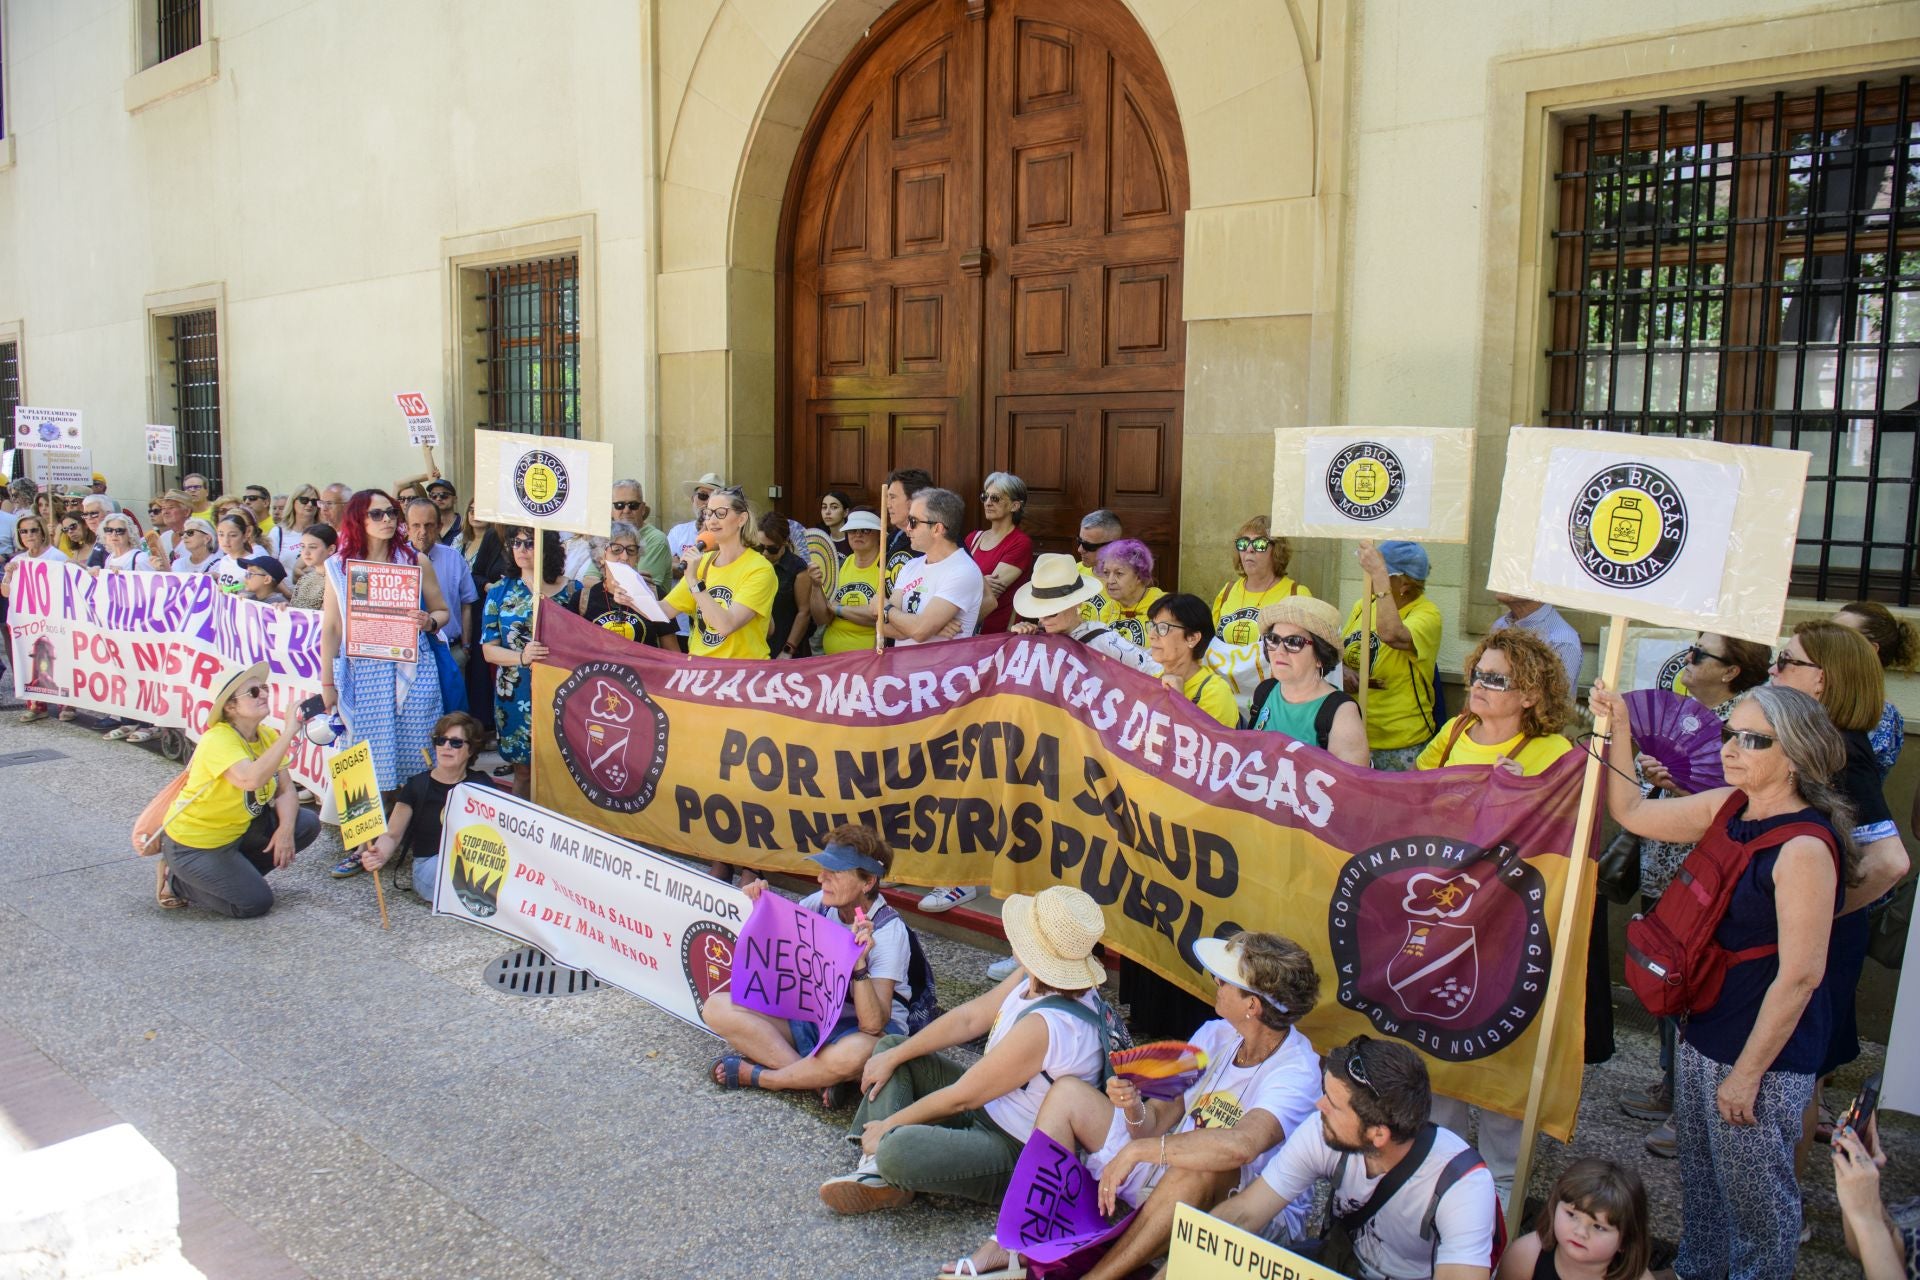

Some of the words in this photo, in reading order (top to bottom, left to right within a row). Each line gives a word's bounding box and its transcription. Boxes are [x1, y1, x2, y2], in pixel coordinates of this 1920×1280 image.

[399, 396, 426, 415] NO
[517, 455, 533, 485] STOP
[1330, 450, 1353, 485] STOP
[522, 496, 562, 513] MOLINA
[1338, 497, 1394, 517] MOLINA
[1576, 476, 1613, 527] STOP
[1629, 470, 1683, 540] BIOGÁS
[370, 573, 402, 588] STOP
[1583, 548, 1664, 582] MOLINA
[15, 559, 51, 617] NO
[63, 564, 77, 620] A
[245, 602, 288, 674] DE
[370, 584, 416, 602] BIOGÁS
[12, 618, 47, 640] STOP
[72, 630, 126, 670] POR
[72, 667, 127, 708] POR
[554, 662, 625, 727] OORDINADORA
[331, 747, 369, 780] ¿BIOGÁS?
[713, 669, 747, 703] A
[746, 669, 813, 709] LAS
[1117, 700, 1171, 765] DE
[1171, 722, 1337, 829] BIOGÁS
[719, 727, 826, 799] POR
[834, 720, 1061, 803] NUESTRA
[561, 748, 599, 800] MURCIA
[674, 783, 783, 851] POR
[461, 846, 478, 864] MAR
[477, 852, 507, 873] MENOR
[462, 834, 481, 850] STOP
[480, 838, 507, 858] BIOGÁS
[464, 796, 496, 822] STOP
[498, 811, 545, 845] BIOGÁS
[549, 832, 580, 860] MAR
[582, 844, 633, 881] MENOR
[643, 869, 662, 893] EL
[665, 877, 742, 923] MIRADOR
[514, 863, 546, 886] POR
[609, 904, 654, 940] SALUD
[662, 931, 672, 949] Y
[1334, 842, 1466, 929] COORDINADORA
[519, 899, 537, 918] LA
[540, 903, 572, 930] DEL
[576, 919, 606, 945] MAR
[609, 934, 659, 972] MENOR
[795, 909, 825, 960] EL
[1523, 888, 1545, 993] BIOGÁS
[1341, 962, 1400, 1034] MURCIA
[1416, 1028, 1440, 1050] DE
[1450, 1005, 1527, 1057] REGIÓN
[1176, 1218, 1194, 1244] NI
[1196, 1227, 1219, 1257] EN
[1223, 1239, 1245, 1267] TU
